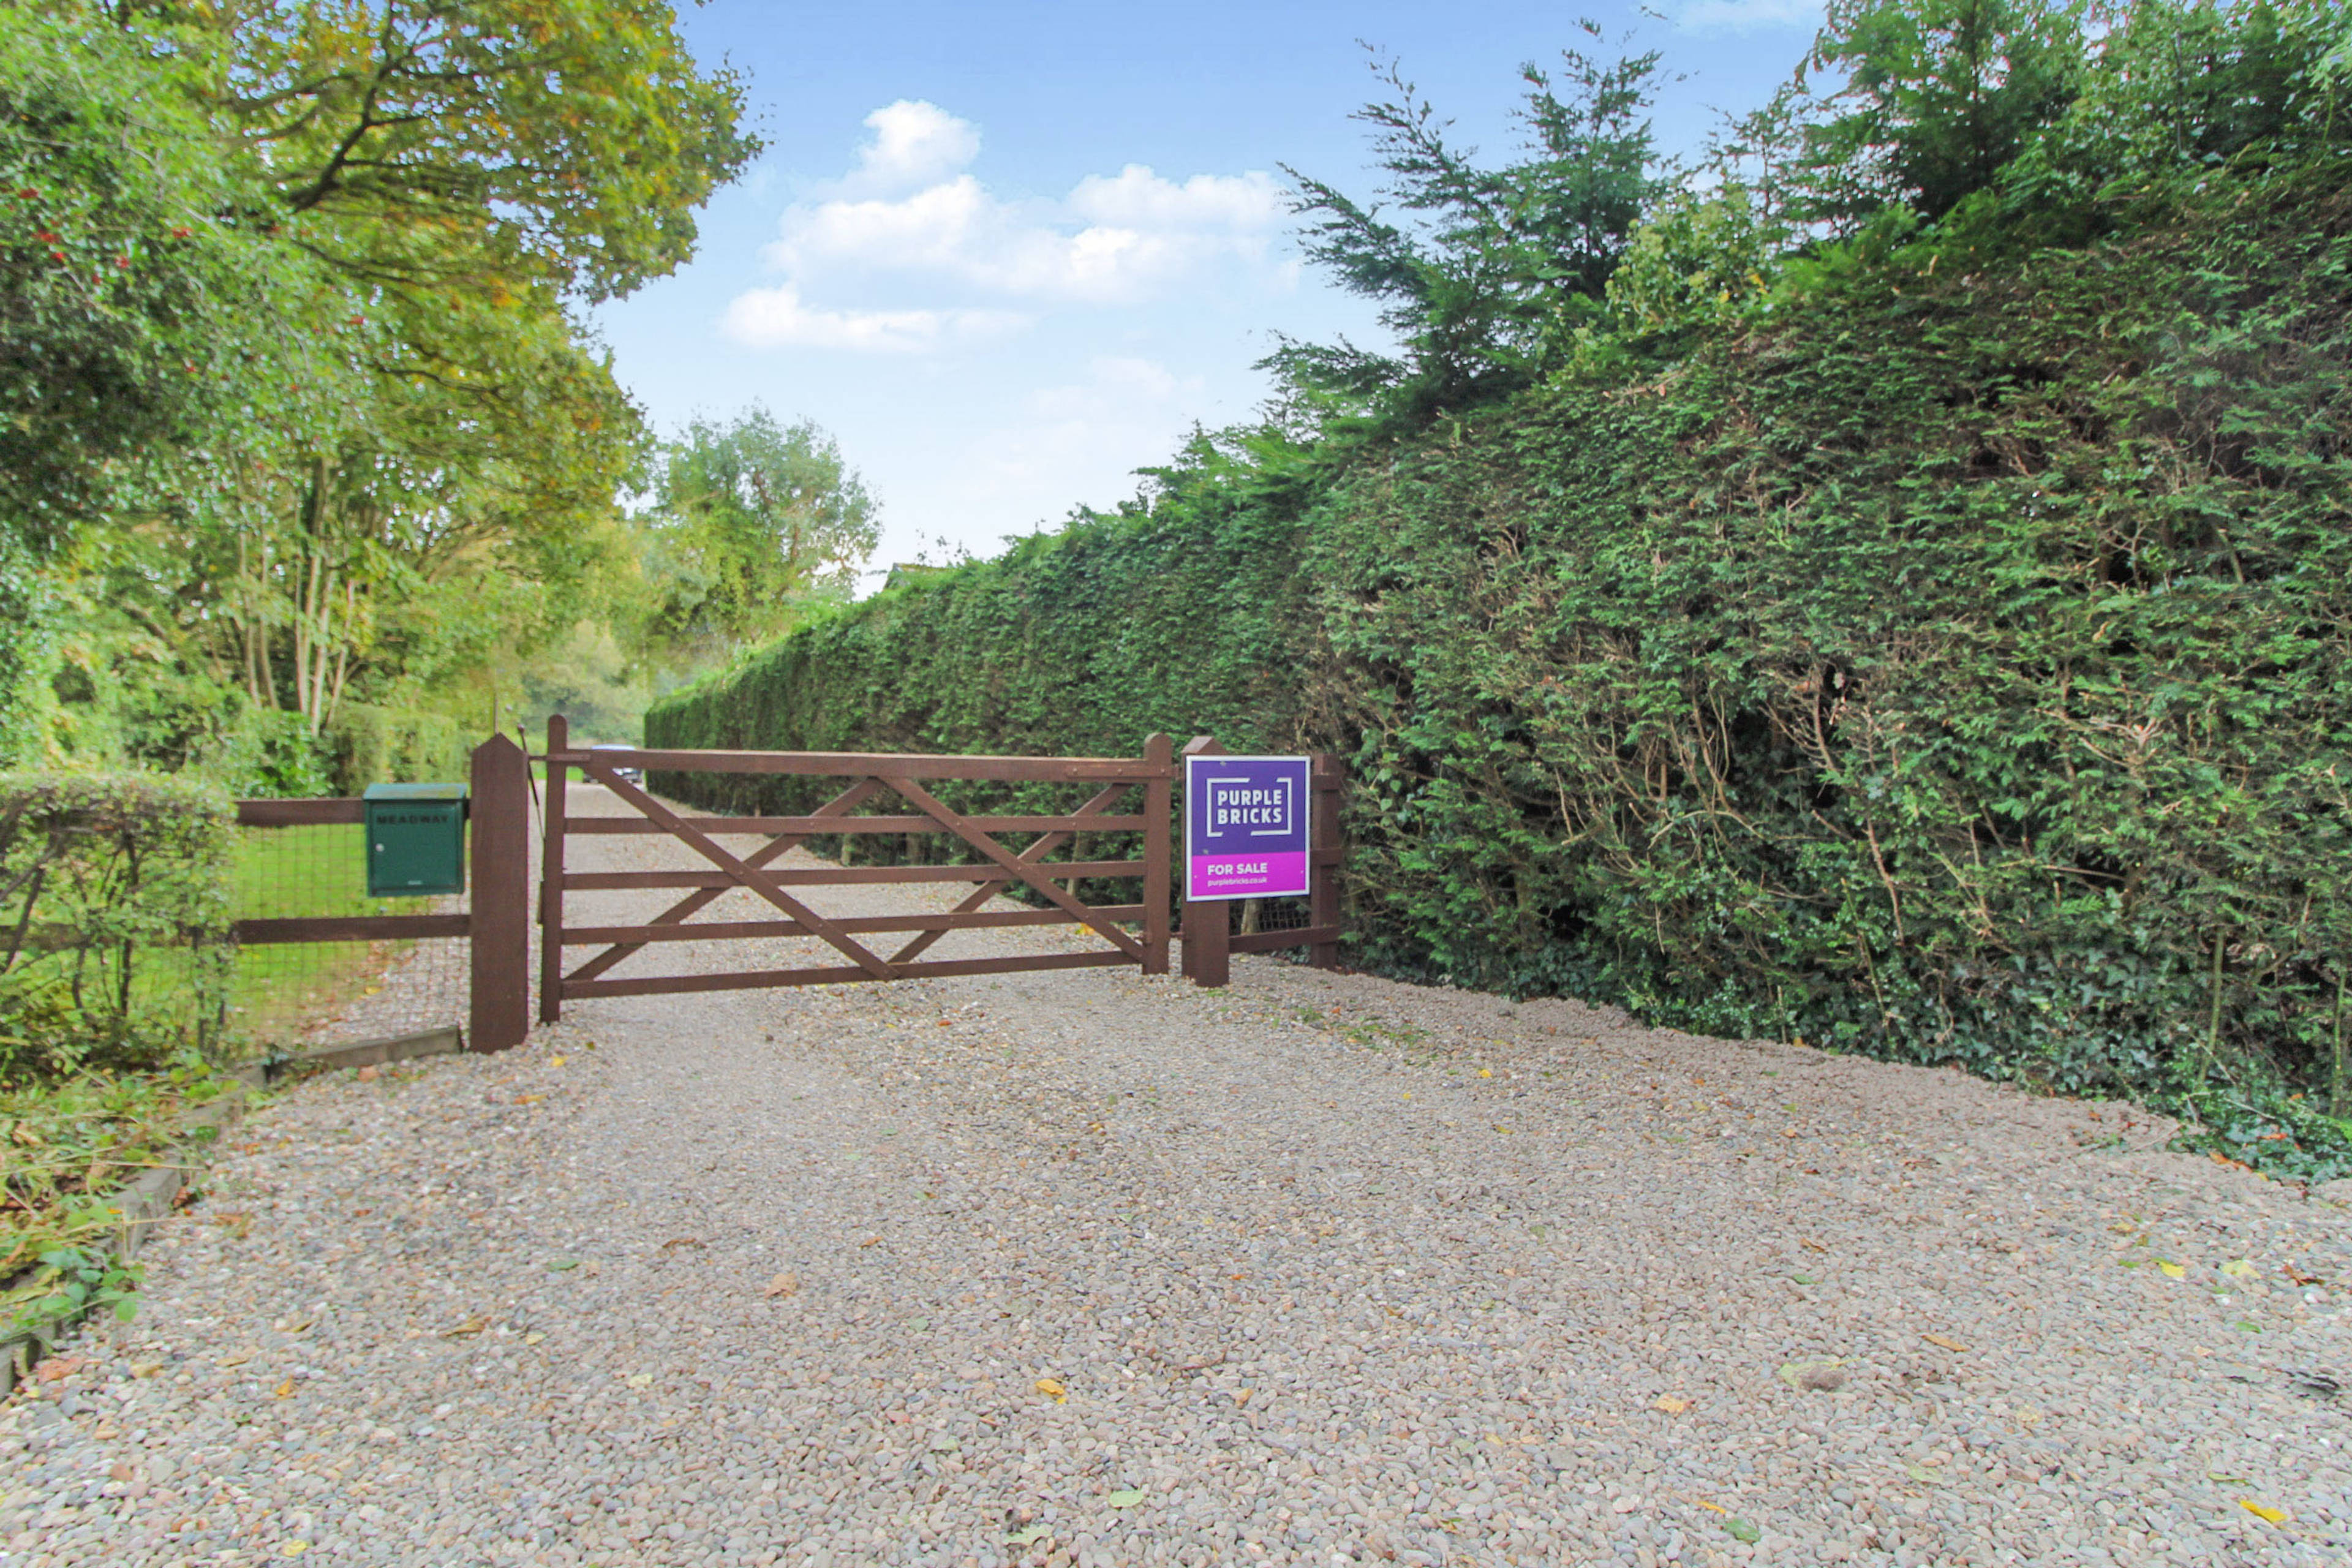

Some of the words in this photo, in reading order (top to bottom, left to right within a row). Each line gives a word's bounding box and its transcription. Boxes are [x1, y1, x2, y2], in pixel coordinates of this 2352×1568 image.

[1218, 790, 1282, 806] PURPLE
[377, 815, 448, 824] MEADWAY
[1218, 808, 1282, 824] BRICKS
[1207, 864, 1233, 875] FOR
[1237, 862, 1267, 874] SALE
